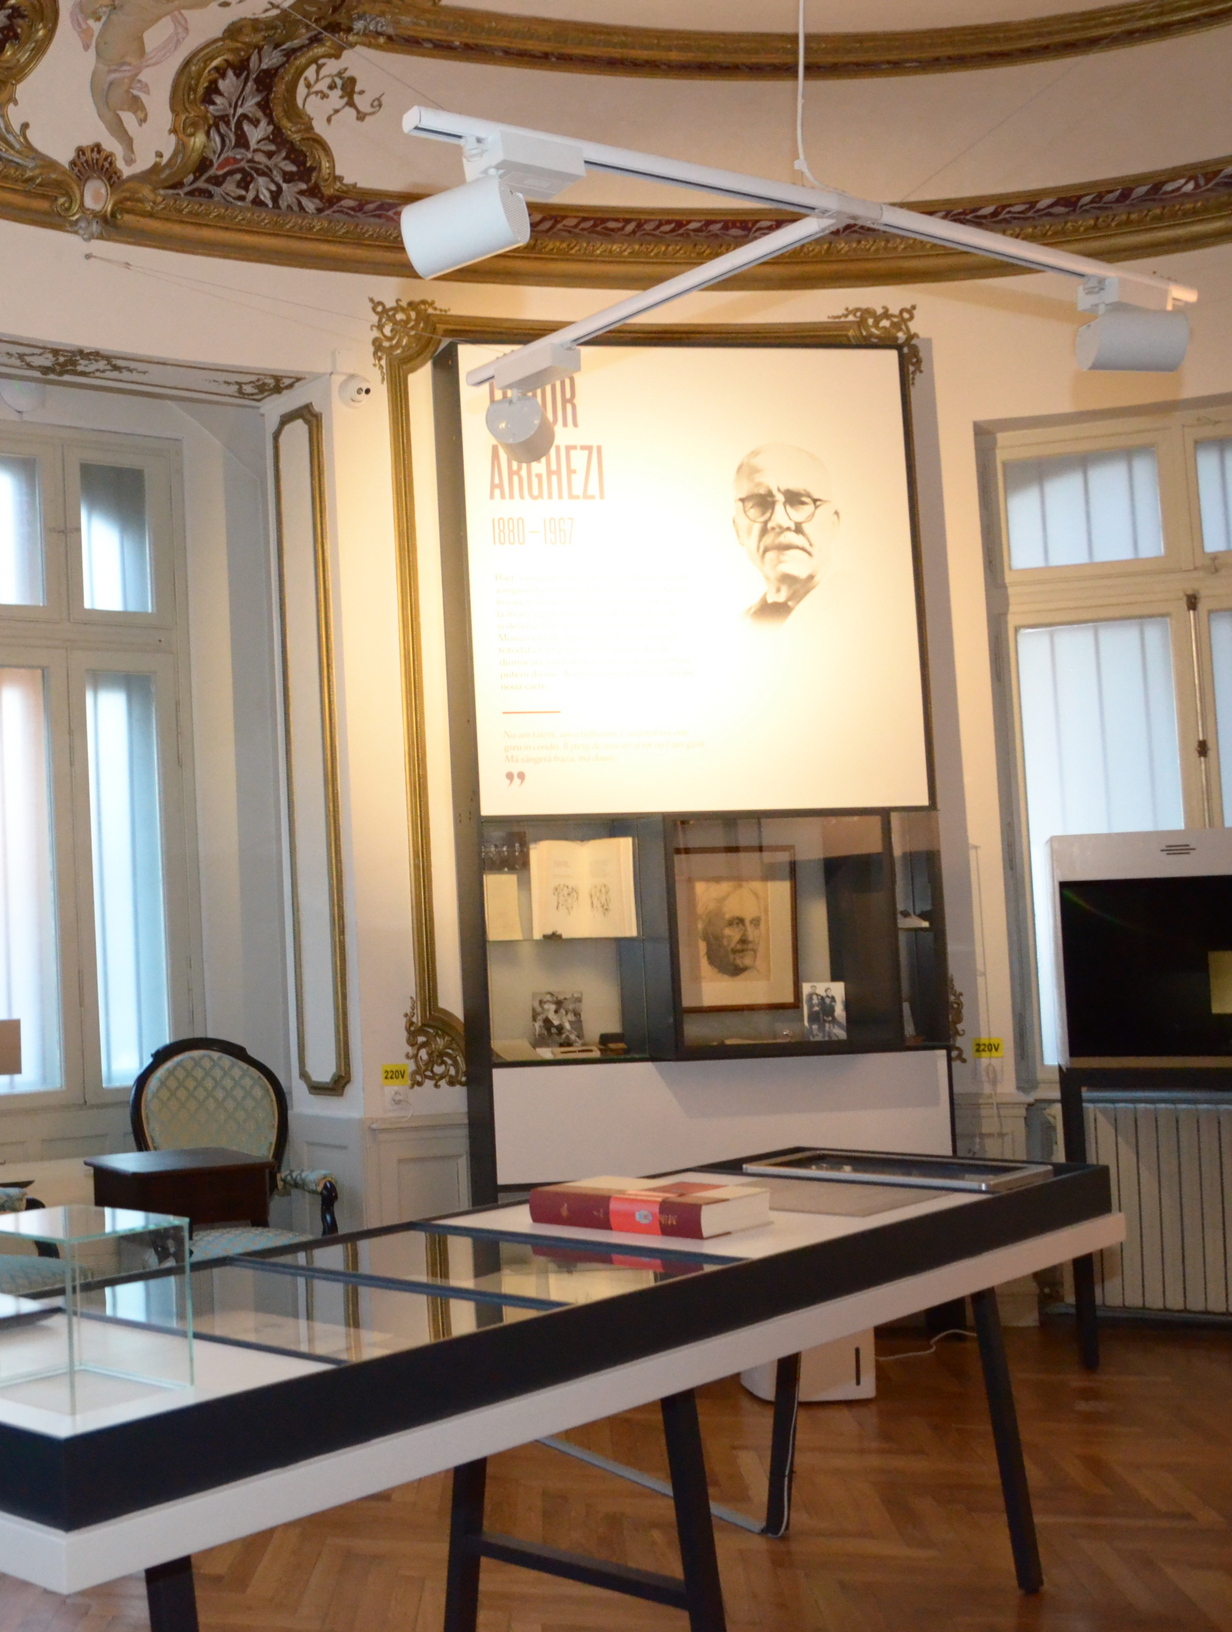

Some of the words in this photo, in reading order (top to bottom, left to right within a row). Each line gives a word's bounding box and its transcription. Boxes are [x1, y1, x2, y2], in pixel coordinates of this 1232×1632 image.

[489, 444, 605, 500] ARGHEZI
[974, 1042, 1000, 1053] 220V
[384, 1069, 406, 1080] 220V
